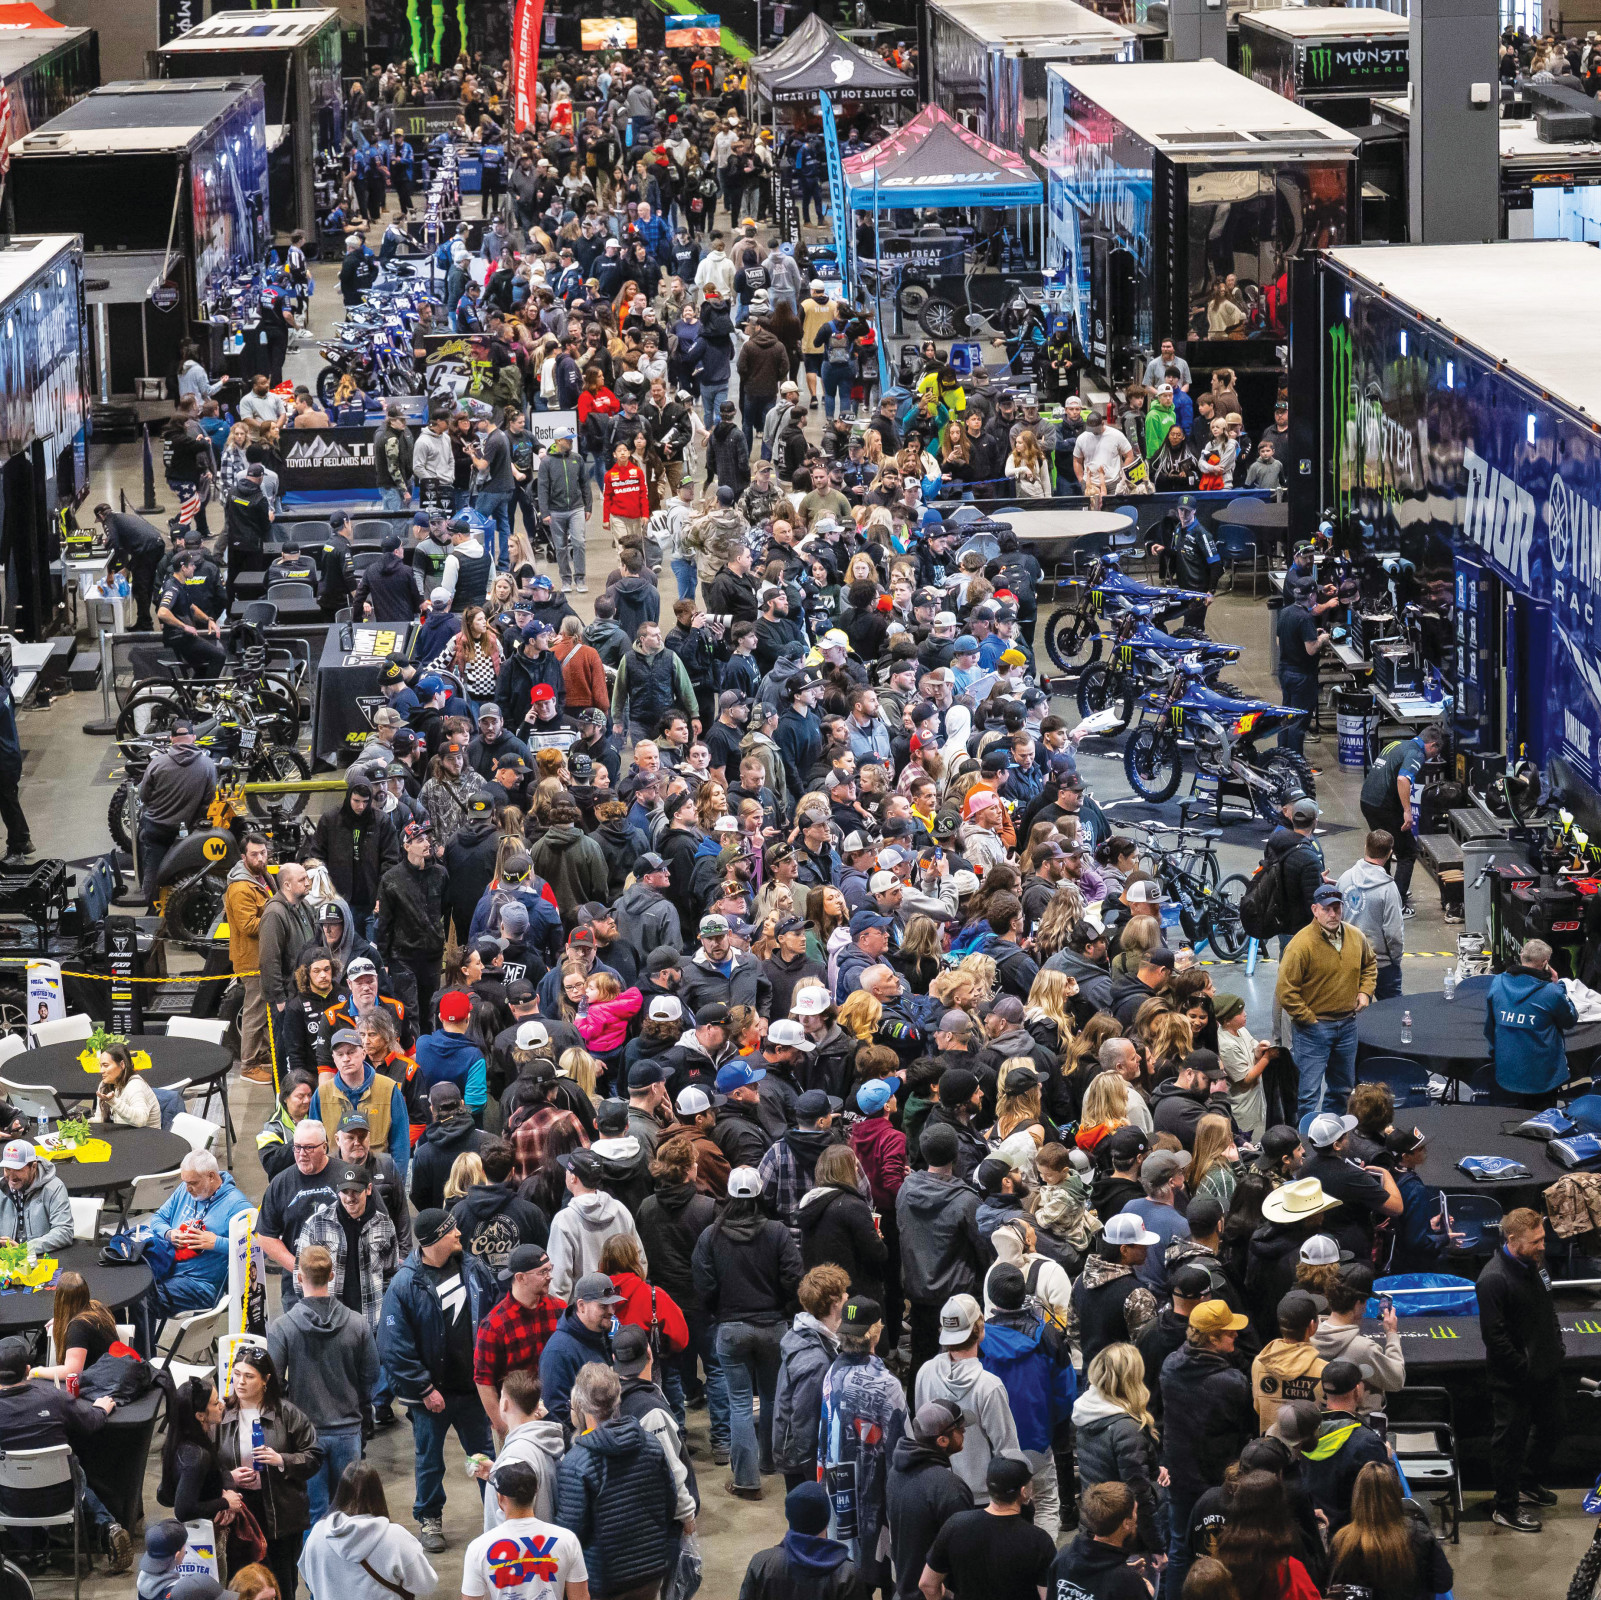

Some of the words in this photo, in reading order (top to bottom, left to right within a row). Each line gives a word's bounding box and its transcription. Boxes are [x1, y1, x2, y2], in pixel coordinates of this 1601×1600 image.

[518, 0, 533, 91] POLISPORT
[841, 90, 863, 98] HOT
[864, 89, 897, 98] SAUCE
[900, 88, 916, 97] CO.
[882, 171, 1000, 186] CLUBMX
[746, 270, 763, 279] VANS
[1049, 290, 1062, 298] 37
[535, 426, 575, 439] Restrs
[286, 458, 312, 468] TOYOTA
[313, 457, 323, 467] OF
[323, 456, 359, 467] REDLANDS
[1129, 463, 1146, 485] 38
[1463, 447, 1536, 588] THOR
[1237, 714, 1253, 734] 38
[242, 733, 257, 741] WAR
[1511, 881, 1534, 891] 17
[1552, 921, 1580, 931] 38
[1500, 1010, 1536, 1026] THOR
[1286, 1380, 1314, 1389] SALTY
[1285, 1387, 1311, 1398] CREW
[1203, 1514, 1226, 1525] DIRTY
[197, 1566, 210, 1575] TEA
